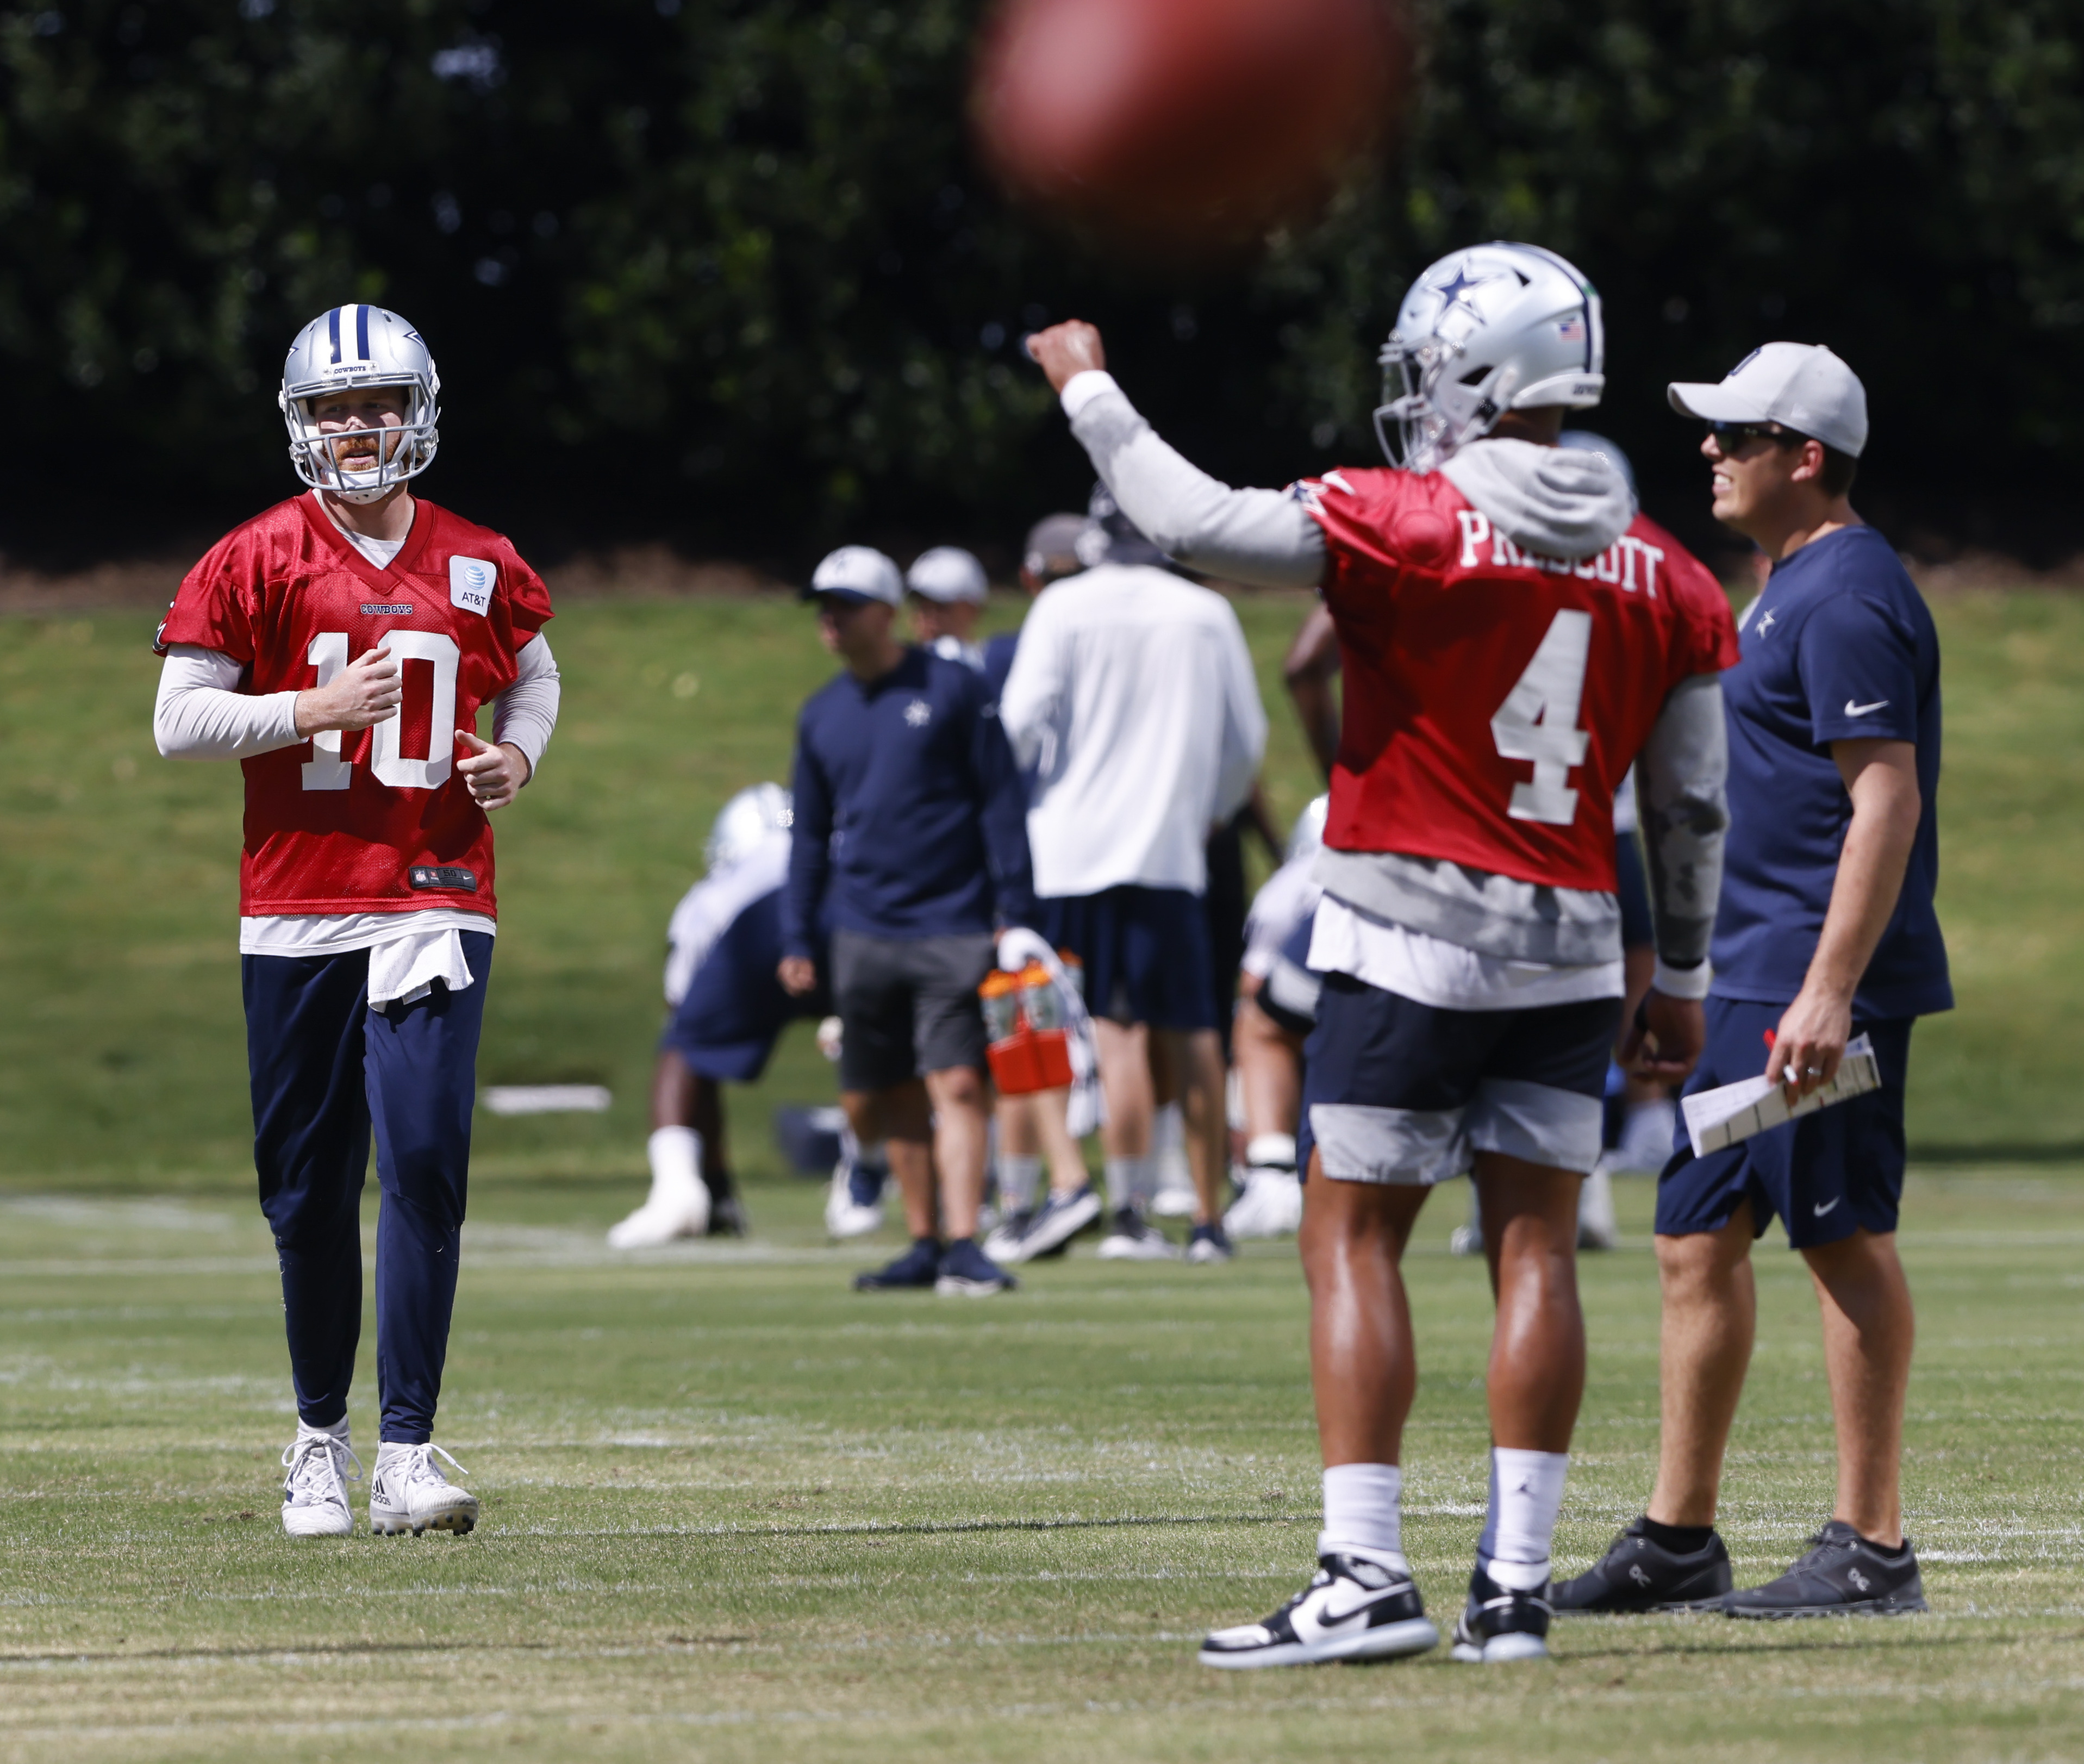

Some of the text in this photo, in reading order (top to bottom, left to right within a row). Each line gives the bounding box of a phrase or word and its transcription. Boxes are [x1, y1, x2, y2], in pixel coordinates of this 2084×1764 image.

[360, 604, 413, 614] COWBOYS
[461, 591, 486, 607] AT&T
[301, 629, 460, 790] 10
[1490, 608, 1593, 826] 4
